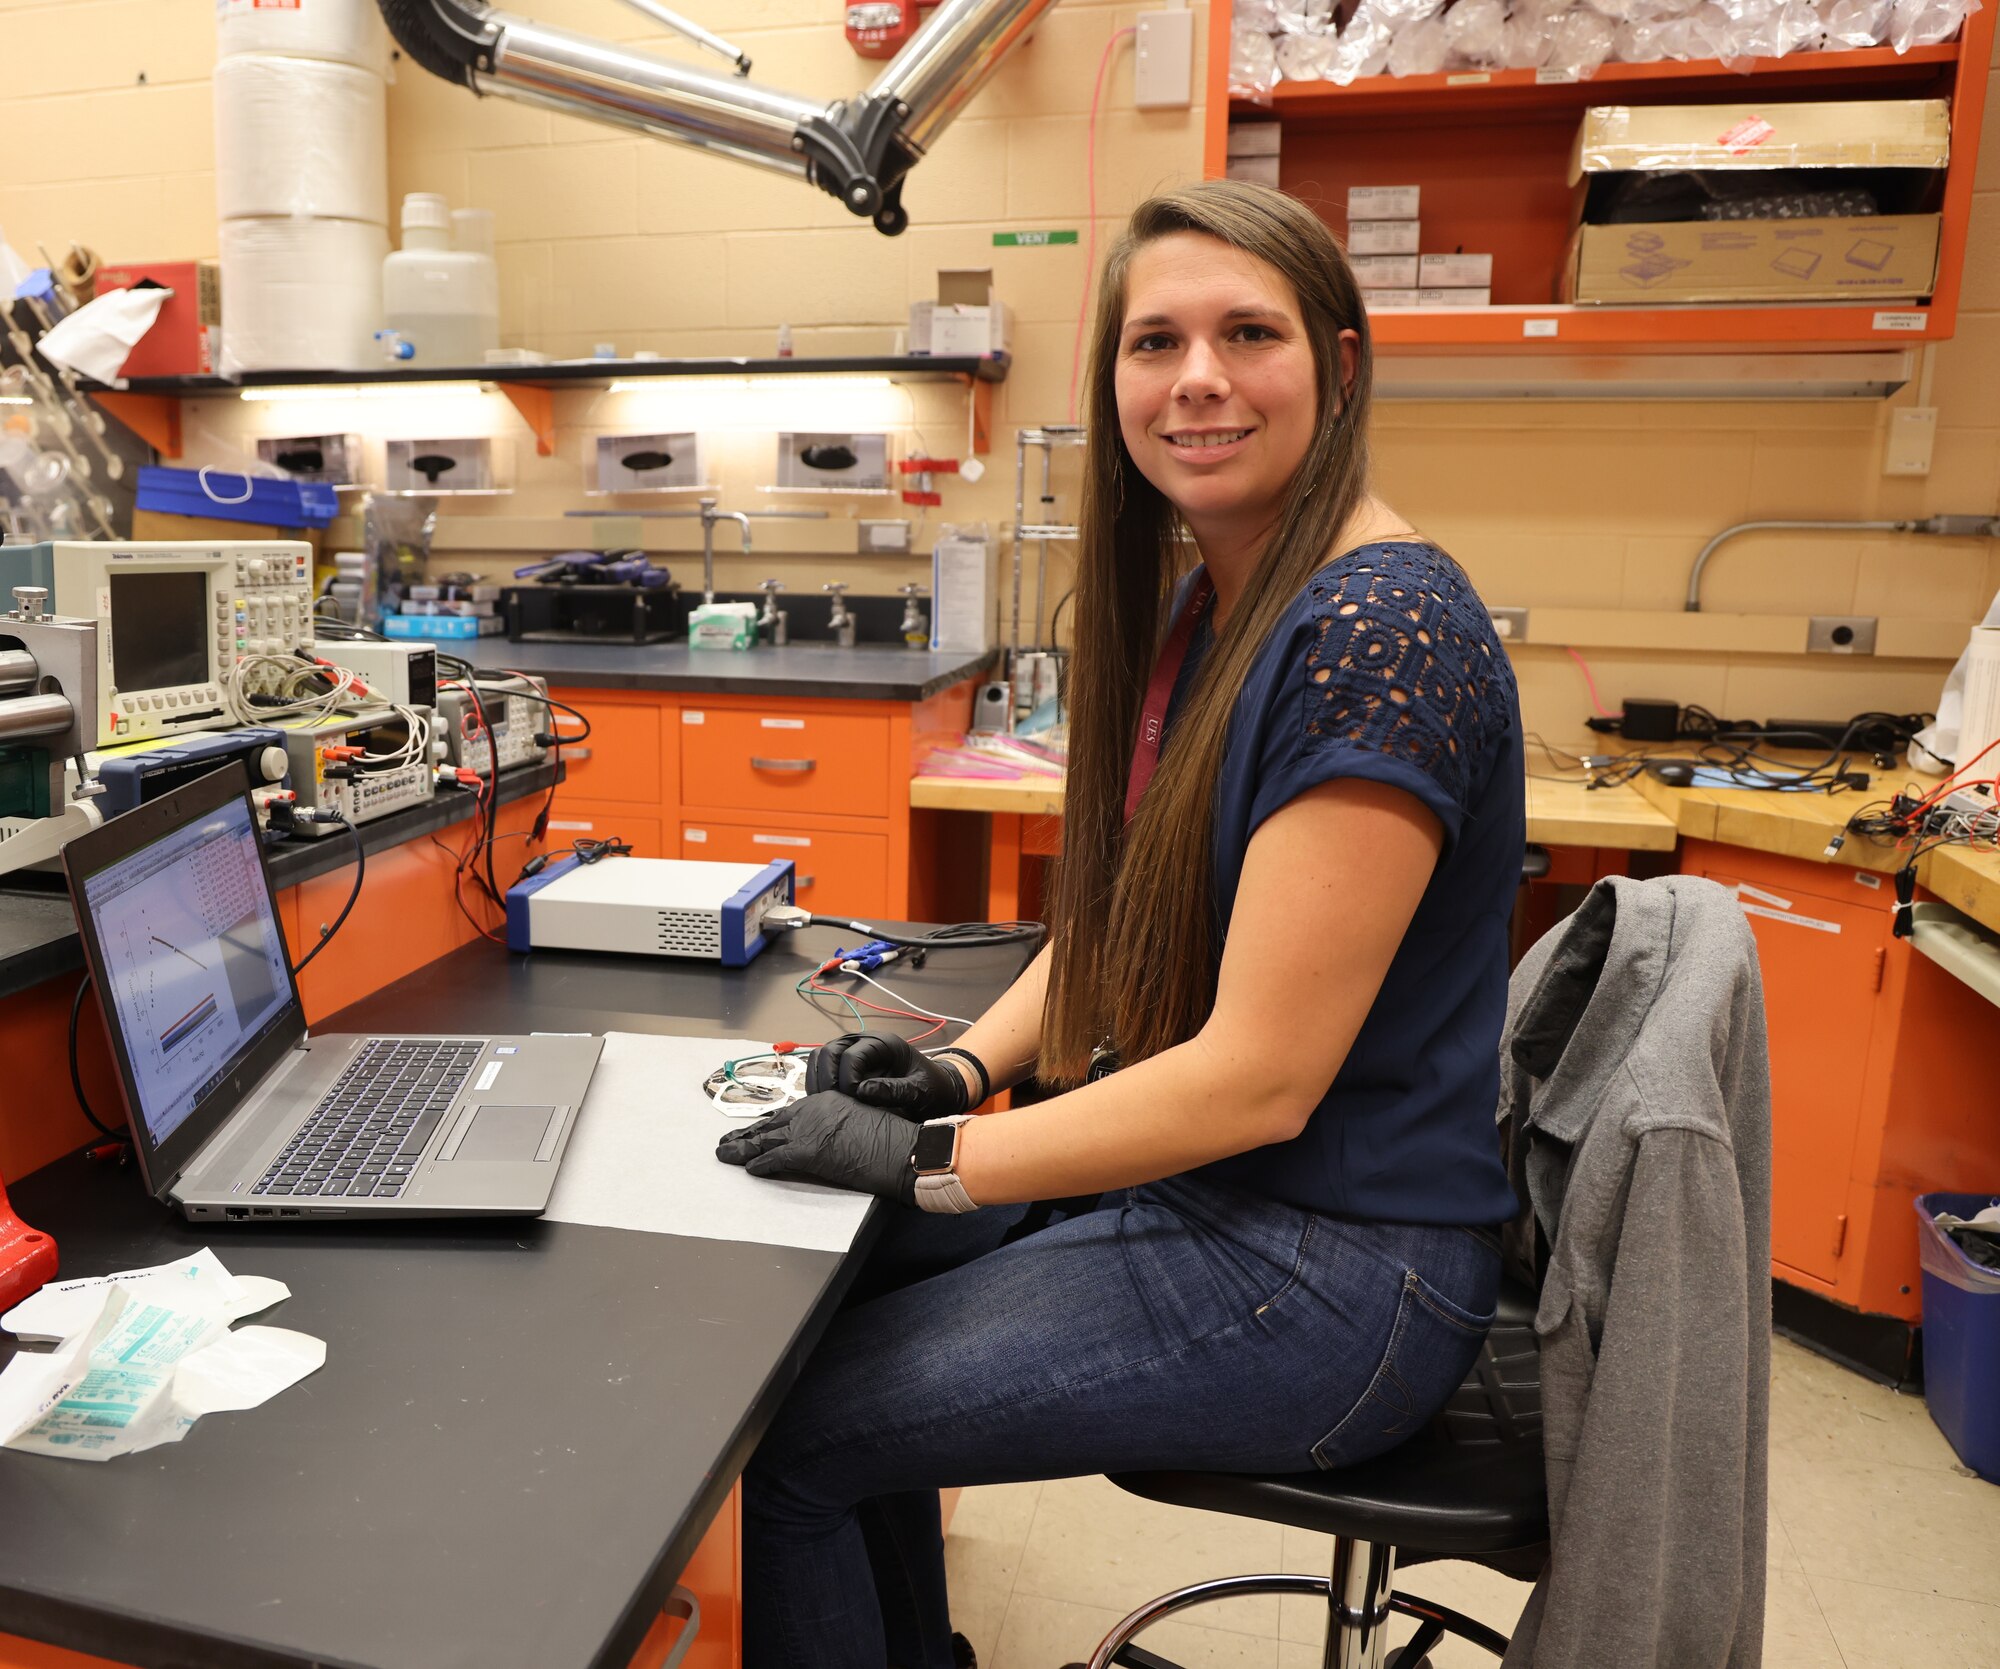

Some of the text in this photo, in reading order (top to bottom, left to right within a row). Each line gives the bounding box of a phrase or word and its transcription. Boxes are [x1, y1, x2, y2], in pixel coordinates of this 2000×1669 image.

[857, 29, 887, 41] FIRE
[1014, 230, 1050, 246] VENT
[1146, 718, 1159, 743] UES
